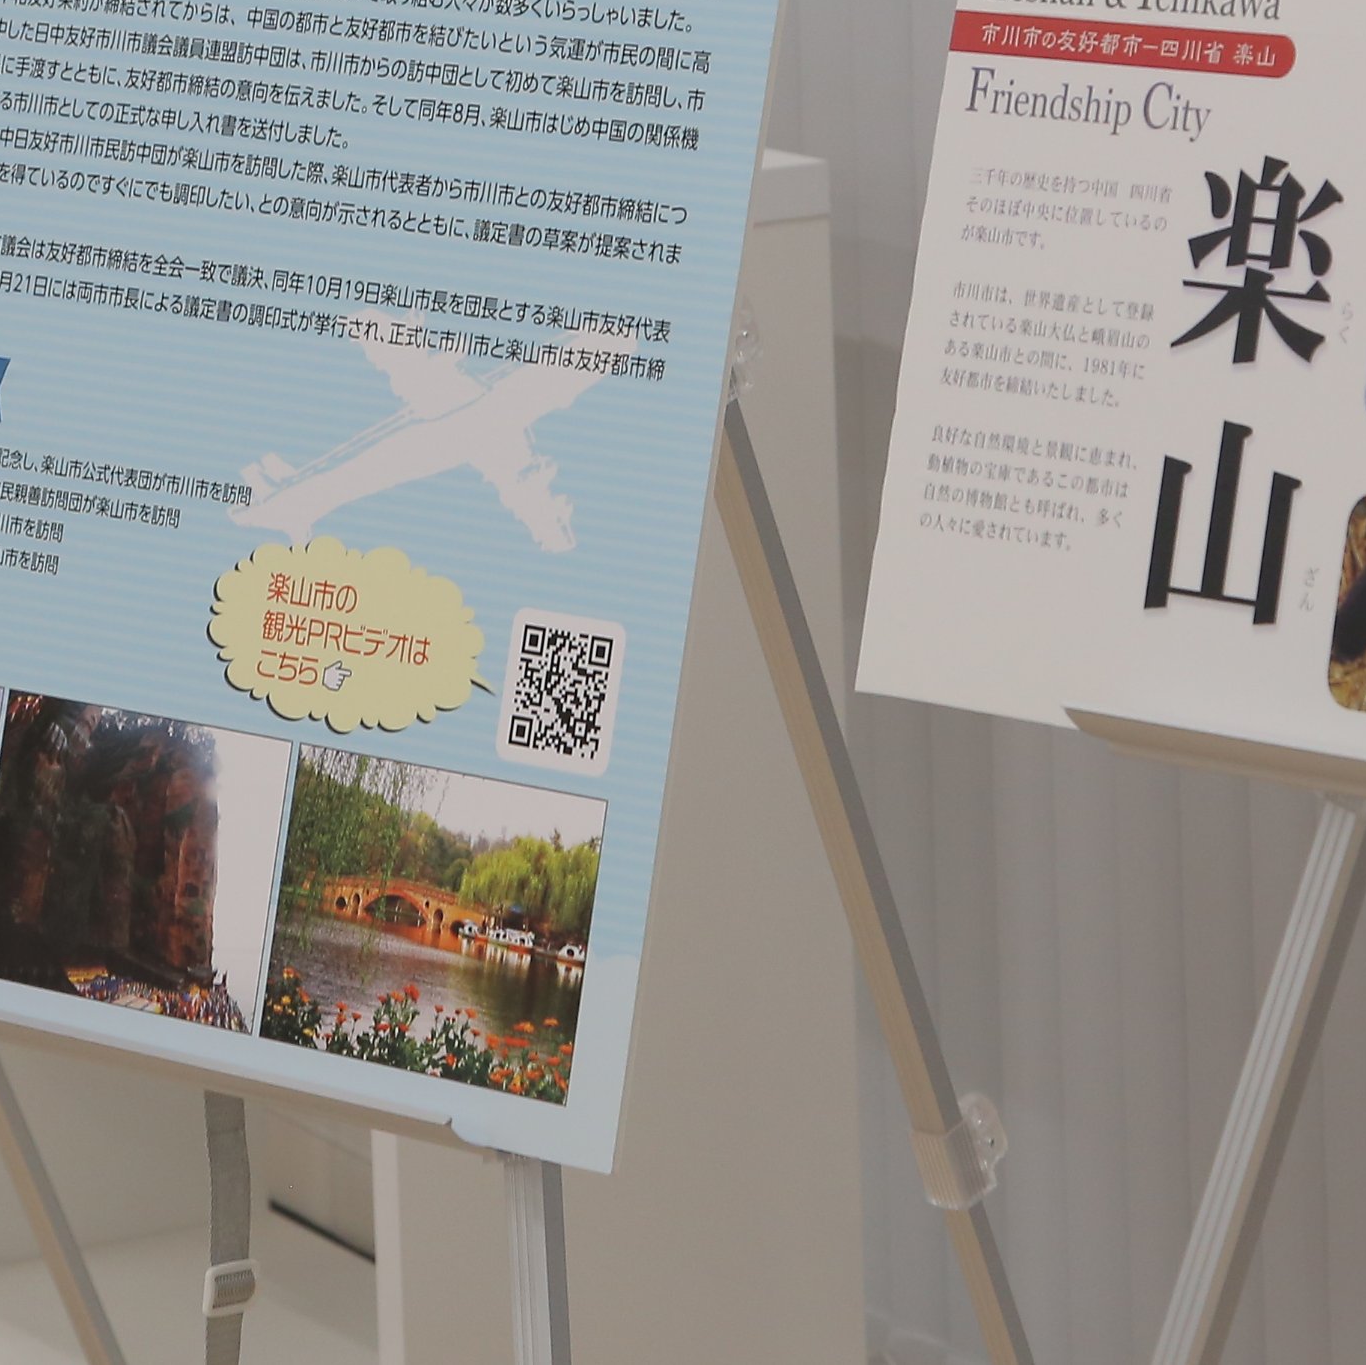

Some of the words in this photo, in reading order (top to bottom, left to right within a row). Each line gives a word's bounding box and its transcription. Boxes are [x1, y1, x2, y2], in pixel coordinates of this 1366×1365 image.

[965, 66, 1132, 136] Friendship
[1142, 80, 1212, 141] City
[266, 571, 358, 613] 楽山市の
[260, 610, 431, 667] 観光PRビデオは
[255, 651, 319, 688] こちら
